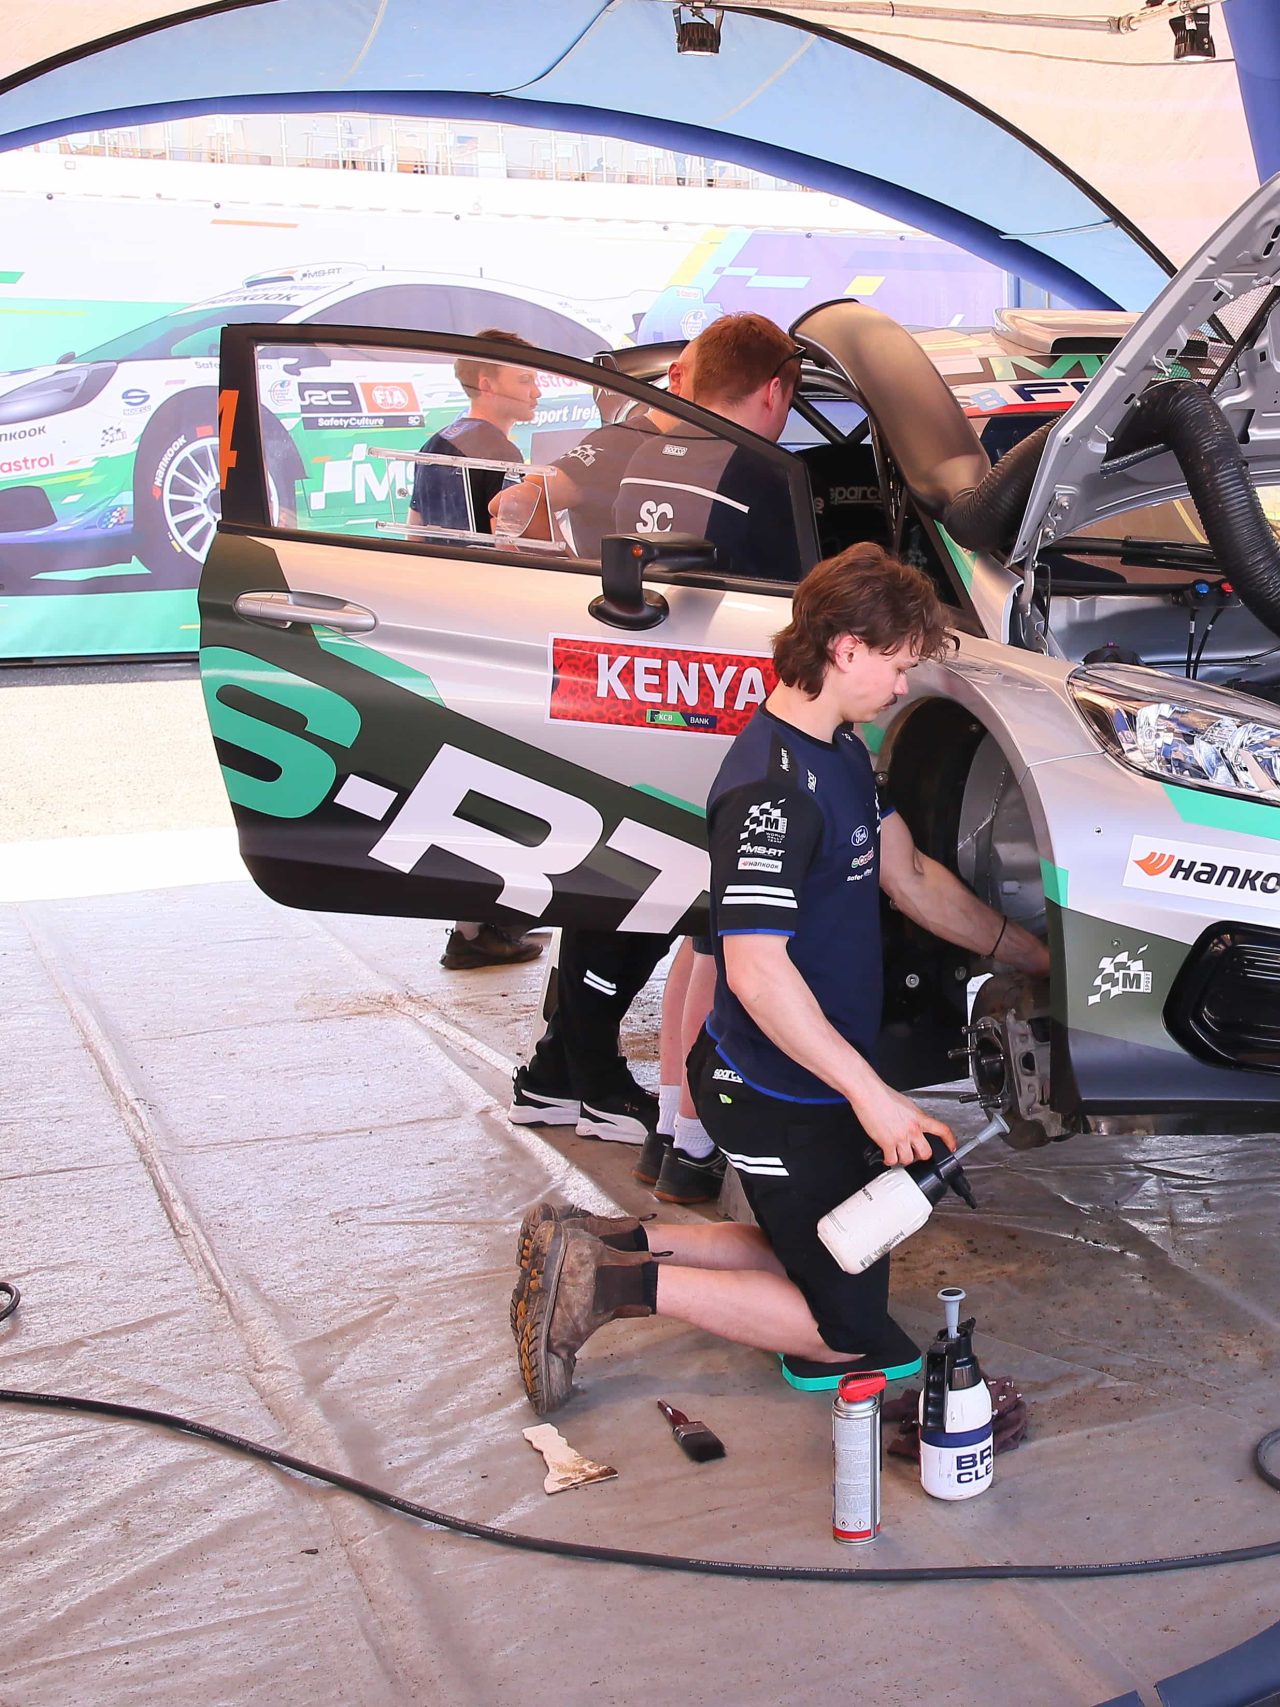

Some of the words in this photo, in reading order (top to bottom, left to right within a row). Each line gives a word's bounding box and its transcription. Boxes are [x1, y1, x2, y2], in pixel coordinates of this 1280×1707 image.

[374, 390, 406, 404] FIA
[318, 417, 385, 428] SafetyCulture
[829, 485, 882, 505] sparc
[635, 500, 674, 534] SC
[596, 653, 767, 711] KENYA
[659, 714, 673, 722] KCB
[690, 716, 709, 725] BANK
[764, 816, 779, 831] M
[746, 845, 785, 857] MS-RT
[1122, 973, 1141, 990] M
